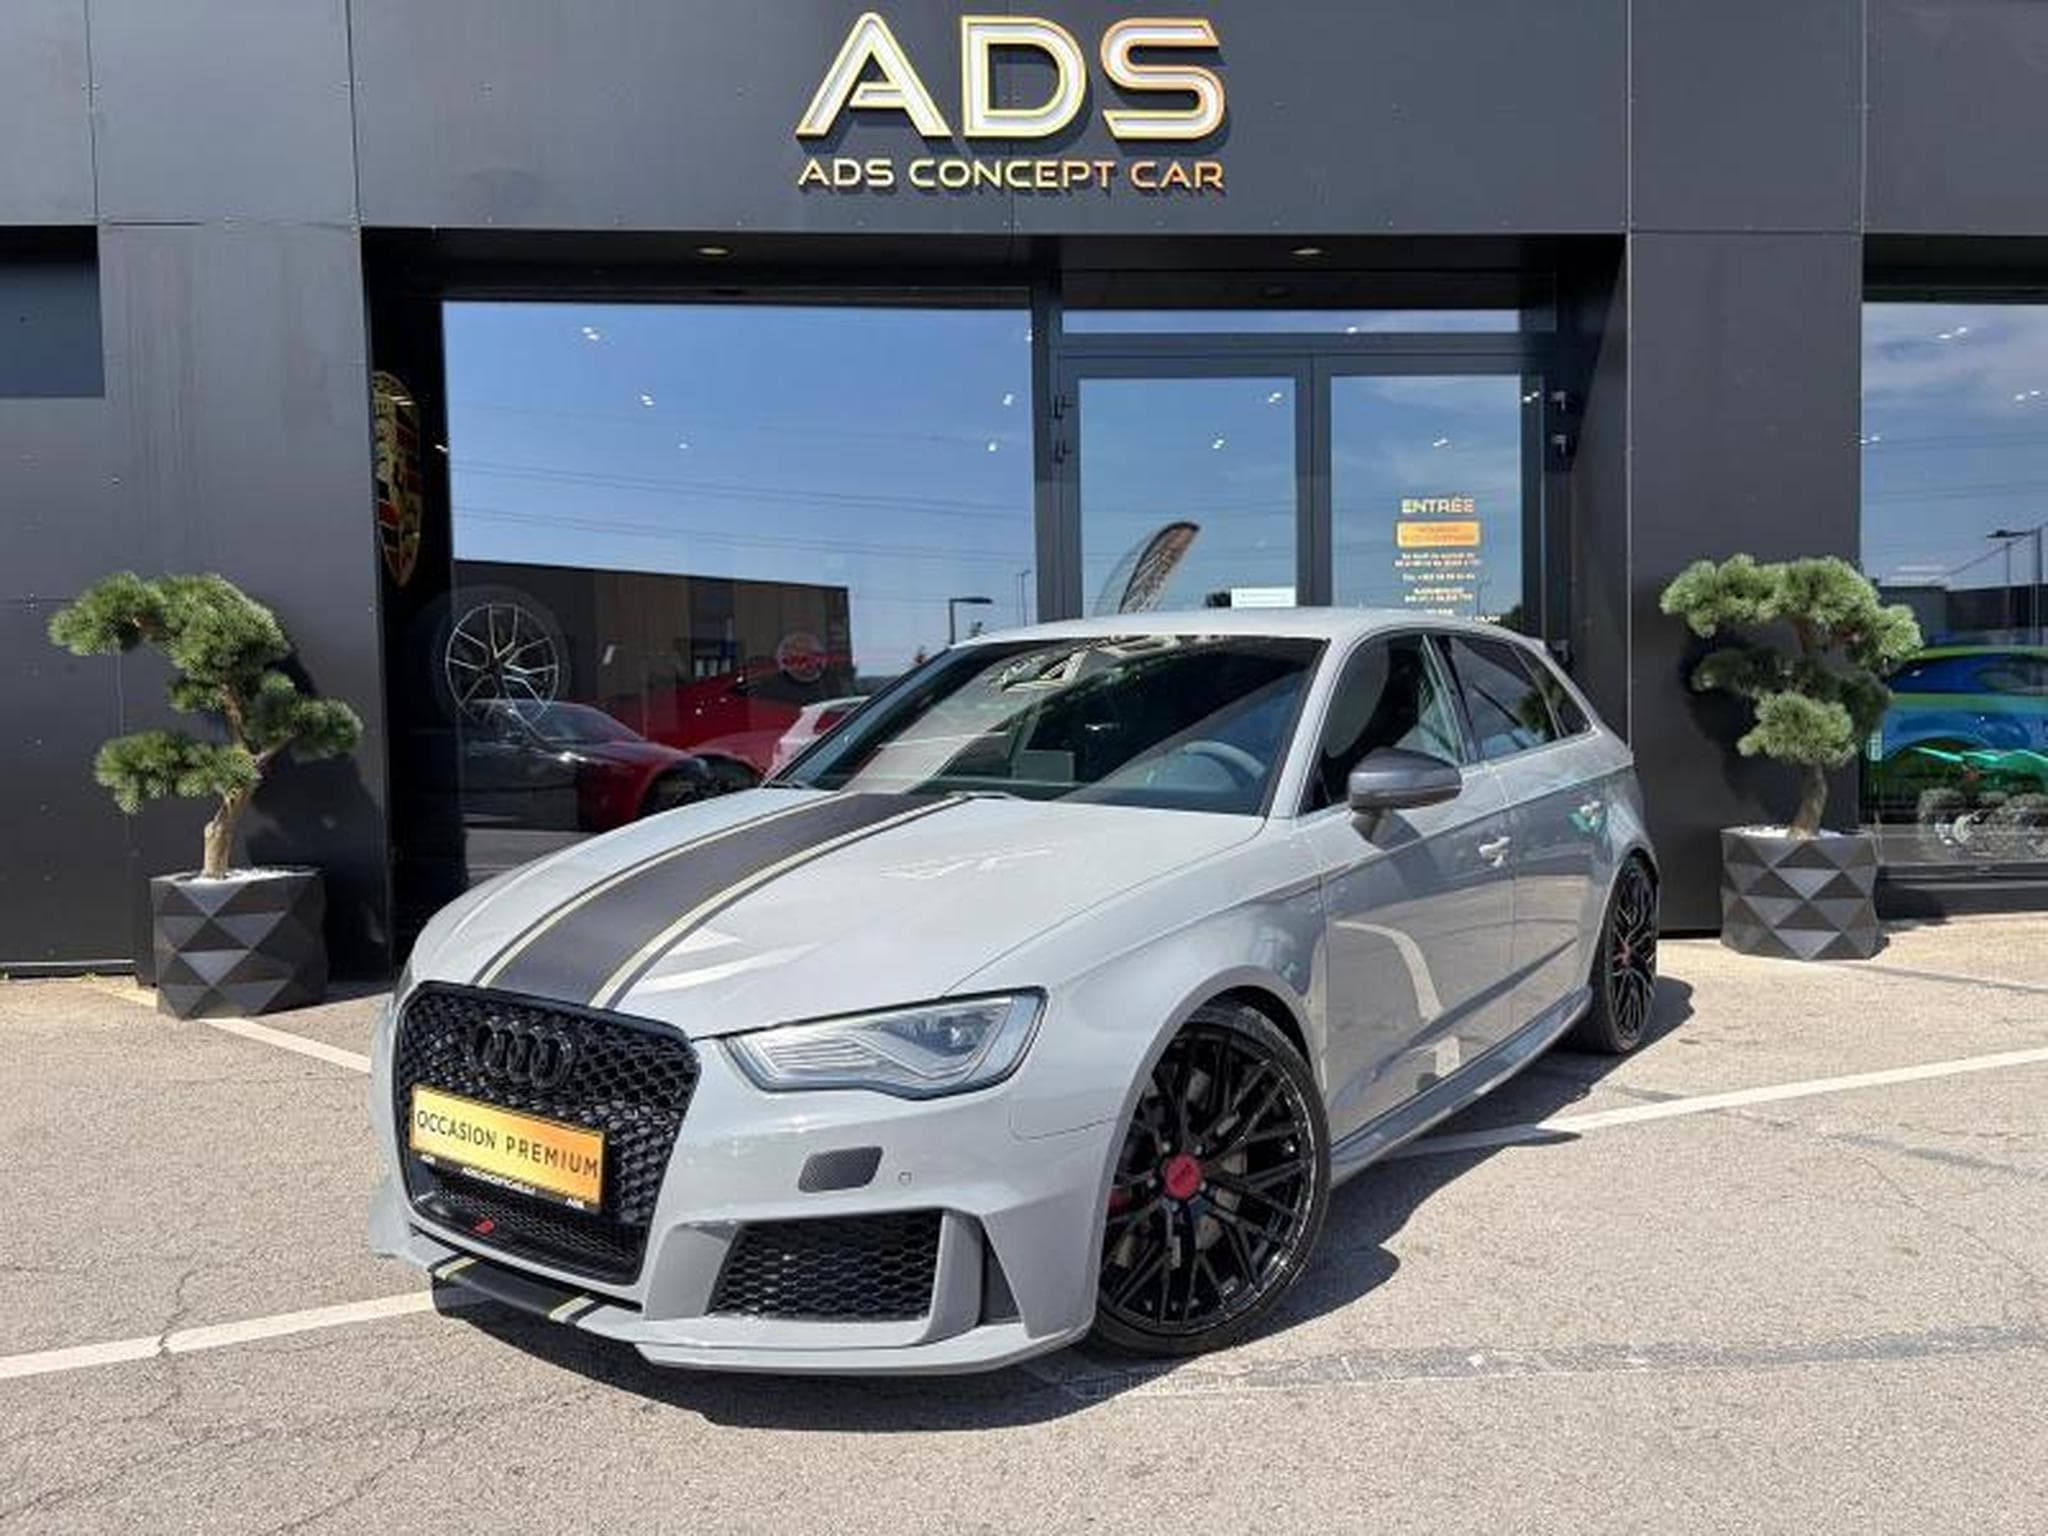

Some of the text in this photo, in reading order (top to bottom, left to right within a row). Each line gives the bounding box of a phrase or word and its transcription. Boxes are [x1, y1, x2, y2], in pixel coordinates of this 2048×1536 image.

[795, 12, 1225, 139] ADS
[798, 158, 1225, 189] ADS CONCEPT CAR
[1402, 496, 1475, 513] ENTRÉE
[416, 1110, 599, 1178] OCCASION PREMIUM
